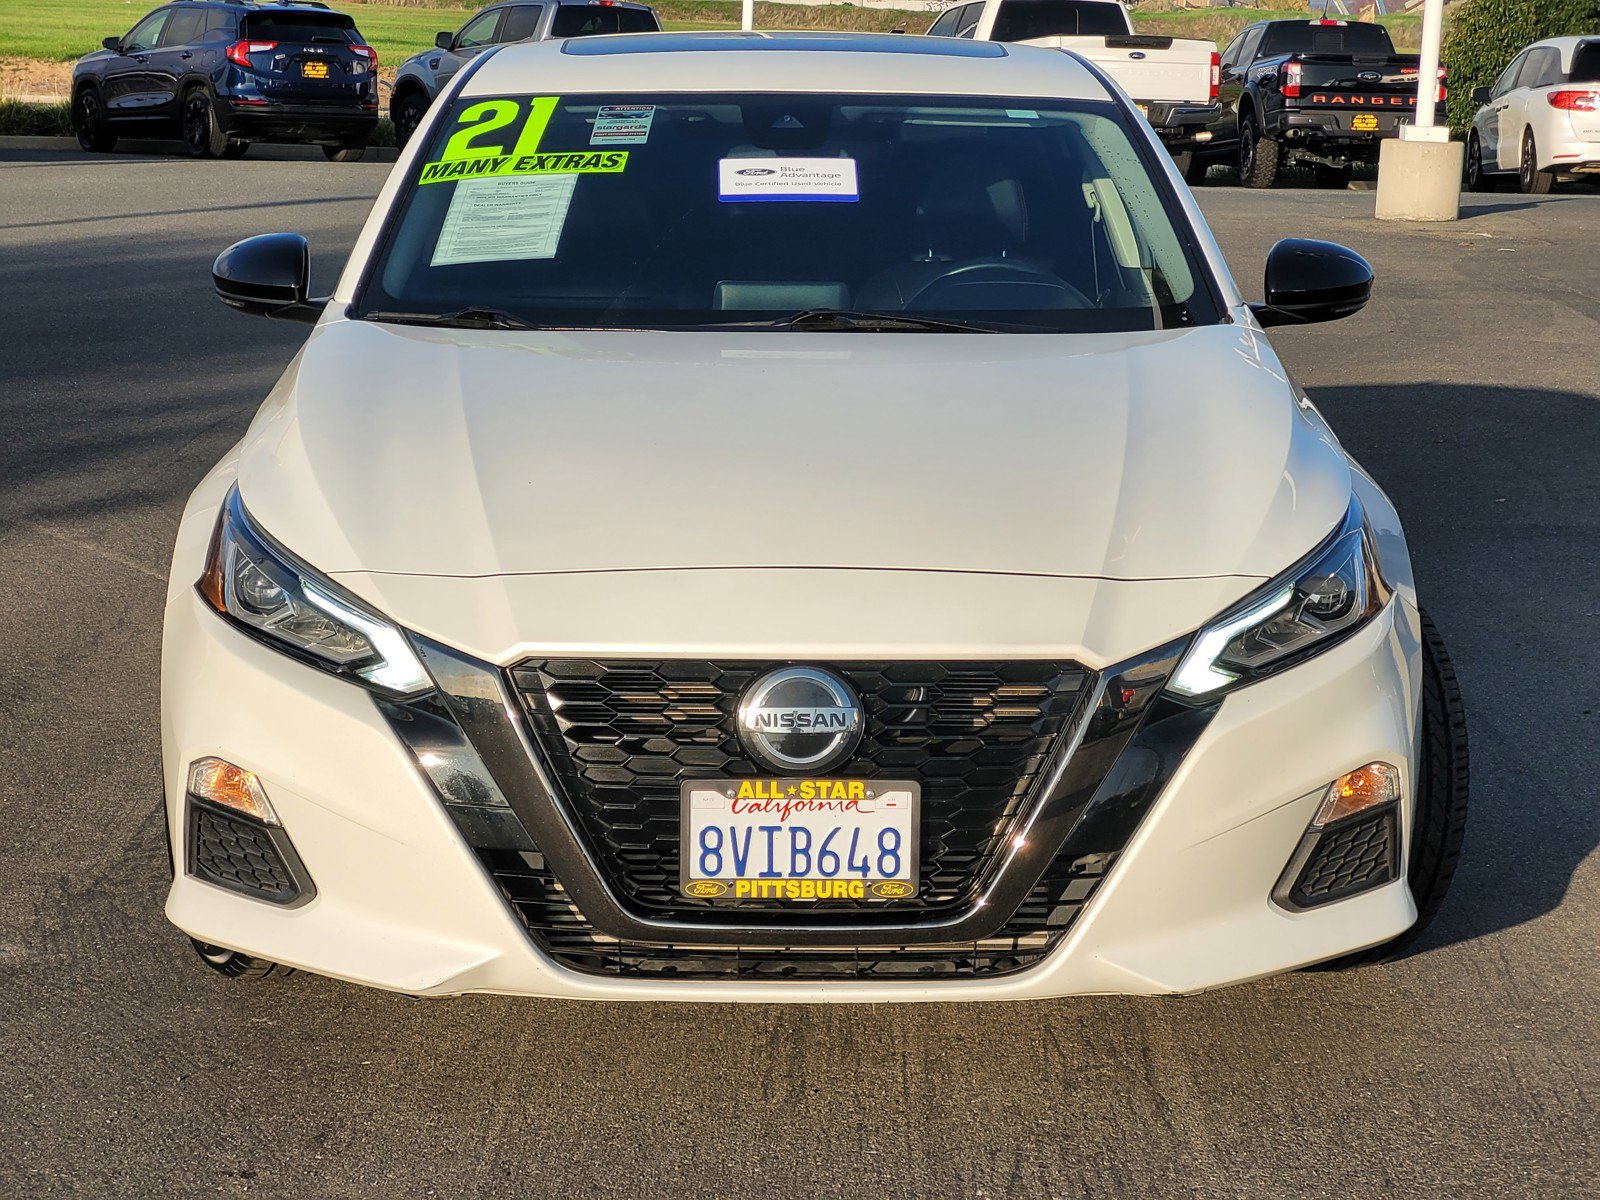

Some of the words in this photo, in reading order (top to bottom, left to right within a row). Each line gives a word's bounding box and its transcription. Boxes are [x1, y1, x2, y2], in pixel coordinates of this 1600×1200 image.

[441, 97, 560, 161] 21
[422, 157, 513, 182] MANY
[513, 153, 625, 173] EXTRAS
[755, 713, 846, 729] NISSAN
[738, 781, 785, 799] ALL
[800, 781, 865, 799] STAR
[731, 798, 875, 822] California
[699, 825, 901, 878] 8VIB648
[735, 880, 865, 898] PITTSBURG
